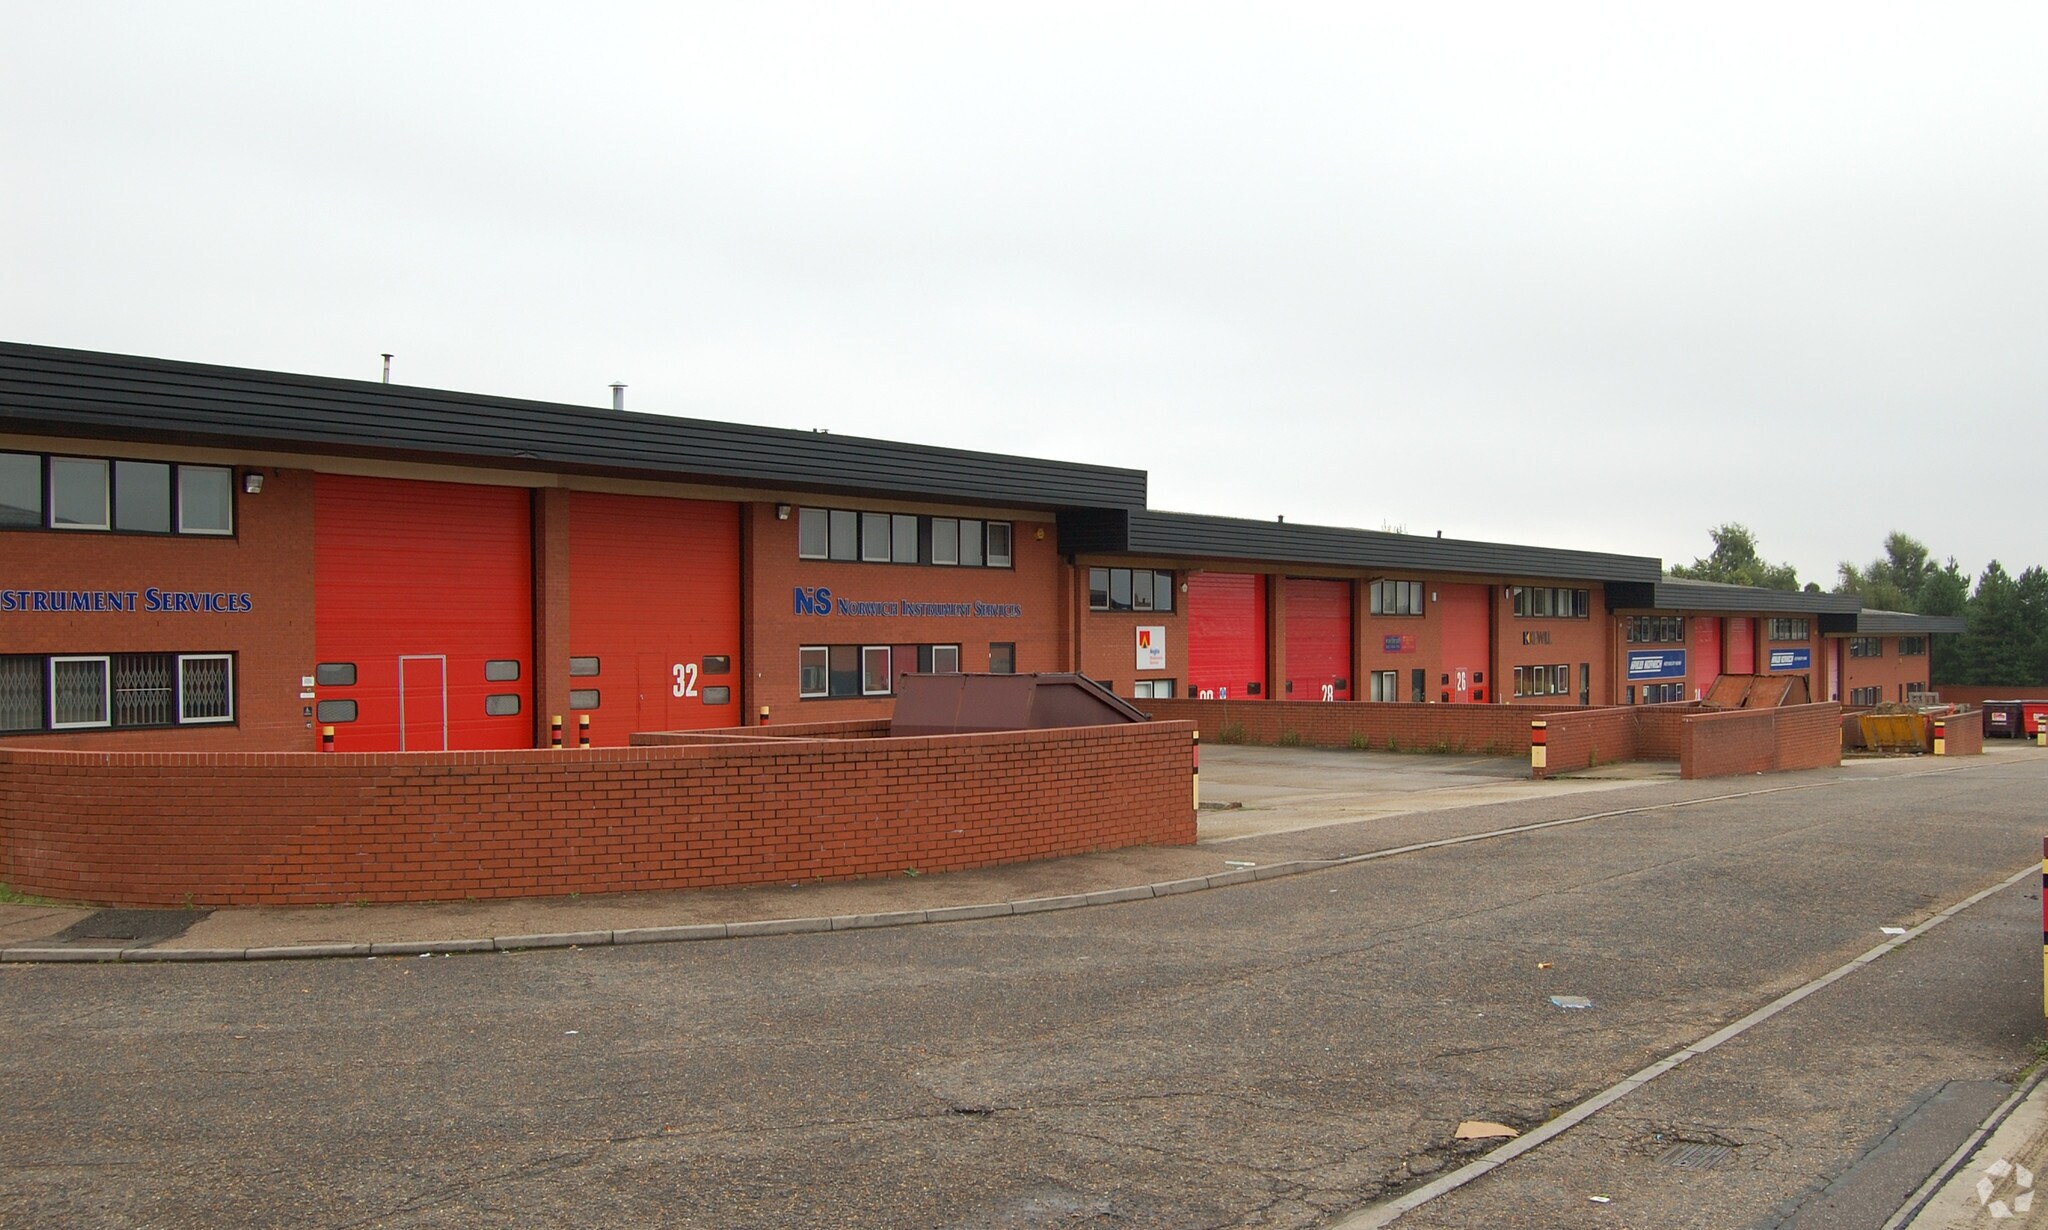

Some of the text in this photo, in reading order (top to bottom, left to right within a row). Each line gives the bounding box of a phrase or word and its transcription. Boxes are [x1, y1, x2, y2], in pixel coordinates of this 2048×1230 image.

[0, 587, 253, 613] STRUMENT SERVICES
[837, 597, 899, 616] NORWICH
[901, 599, 973, 617] INSTRUMENT
[974, 601, 1023, 618] SERVICES
[672, 663, 698, 698] 32
[1456, 671, 1466, 692] 26
[1321, 684, 1334, 702] 28
